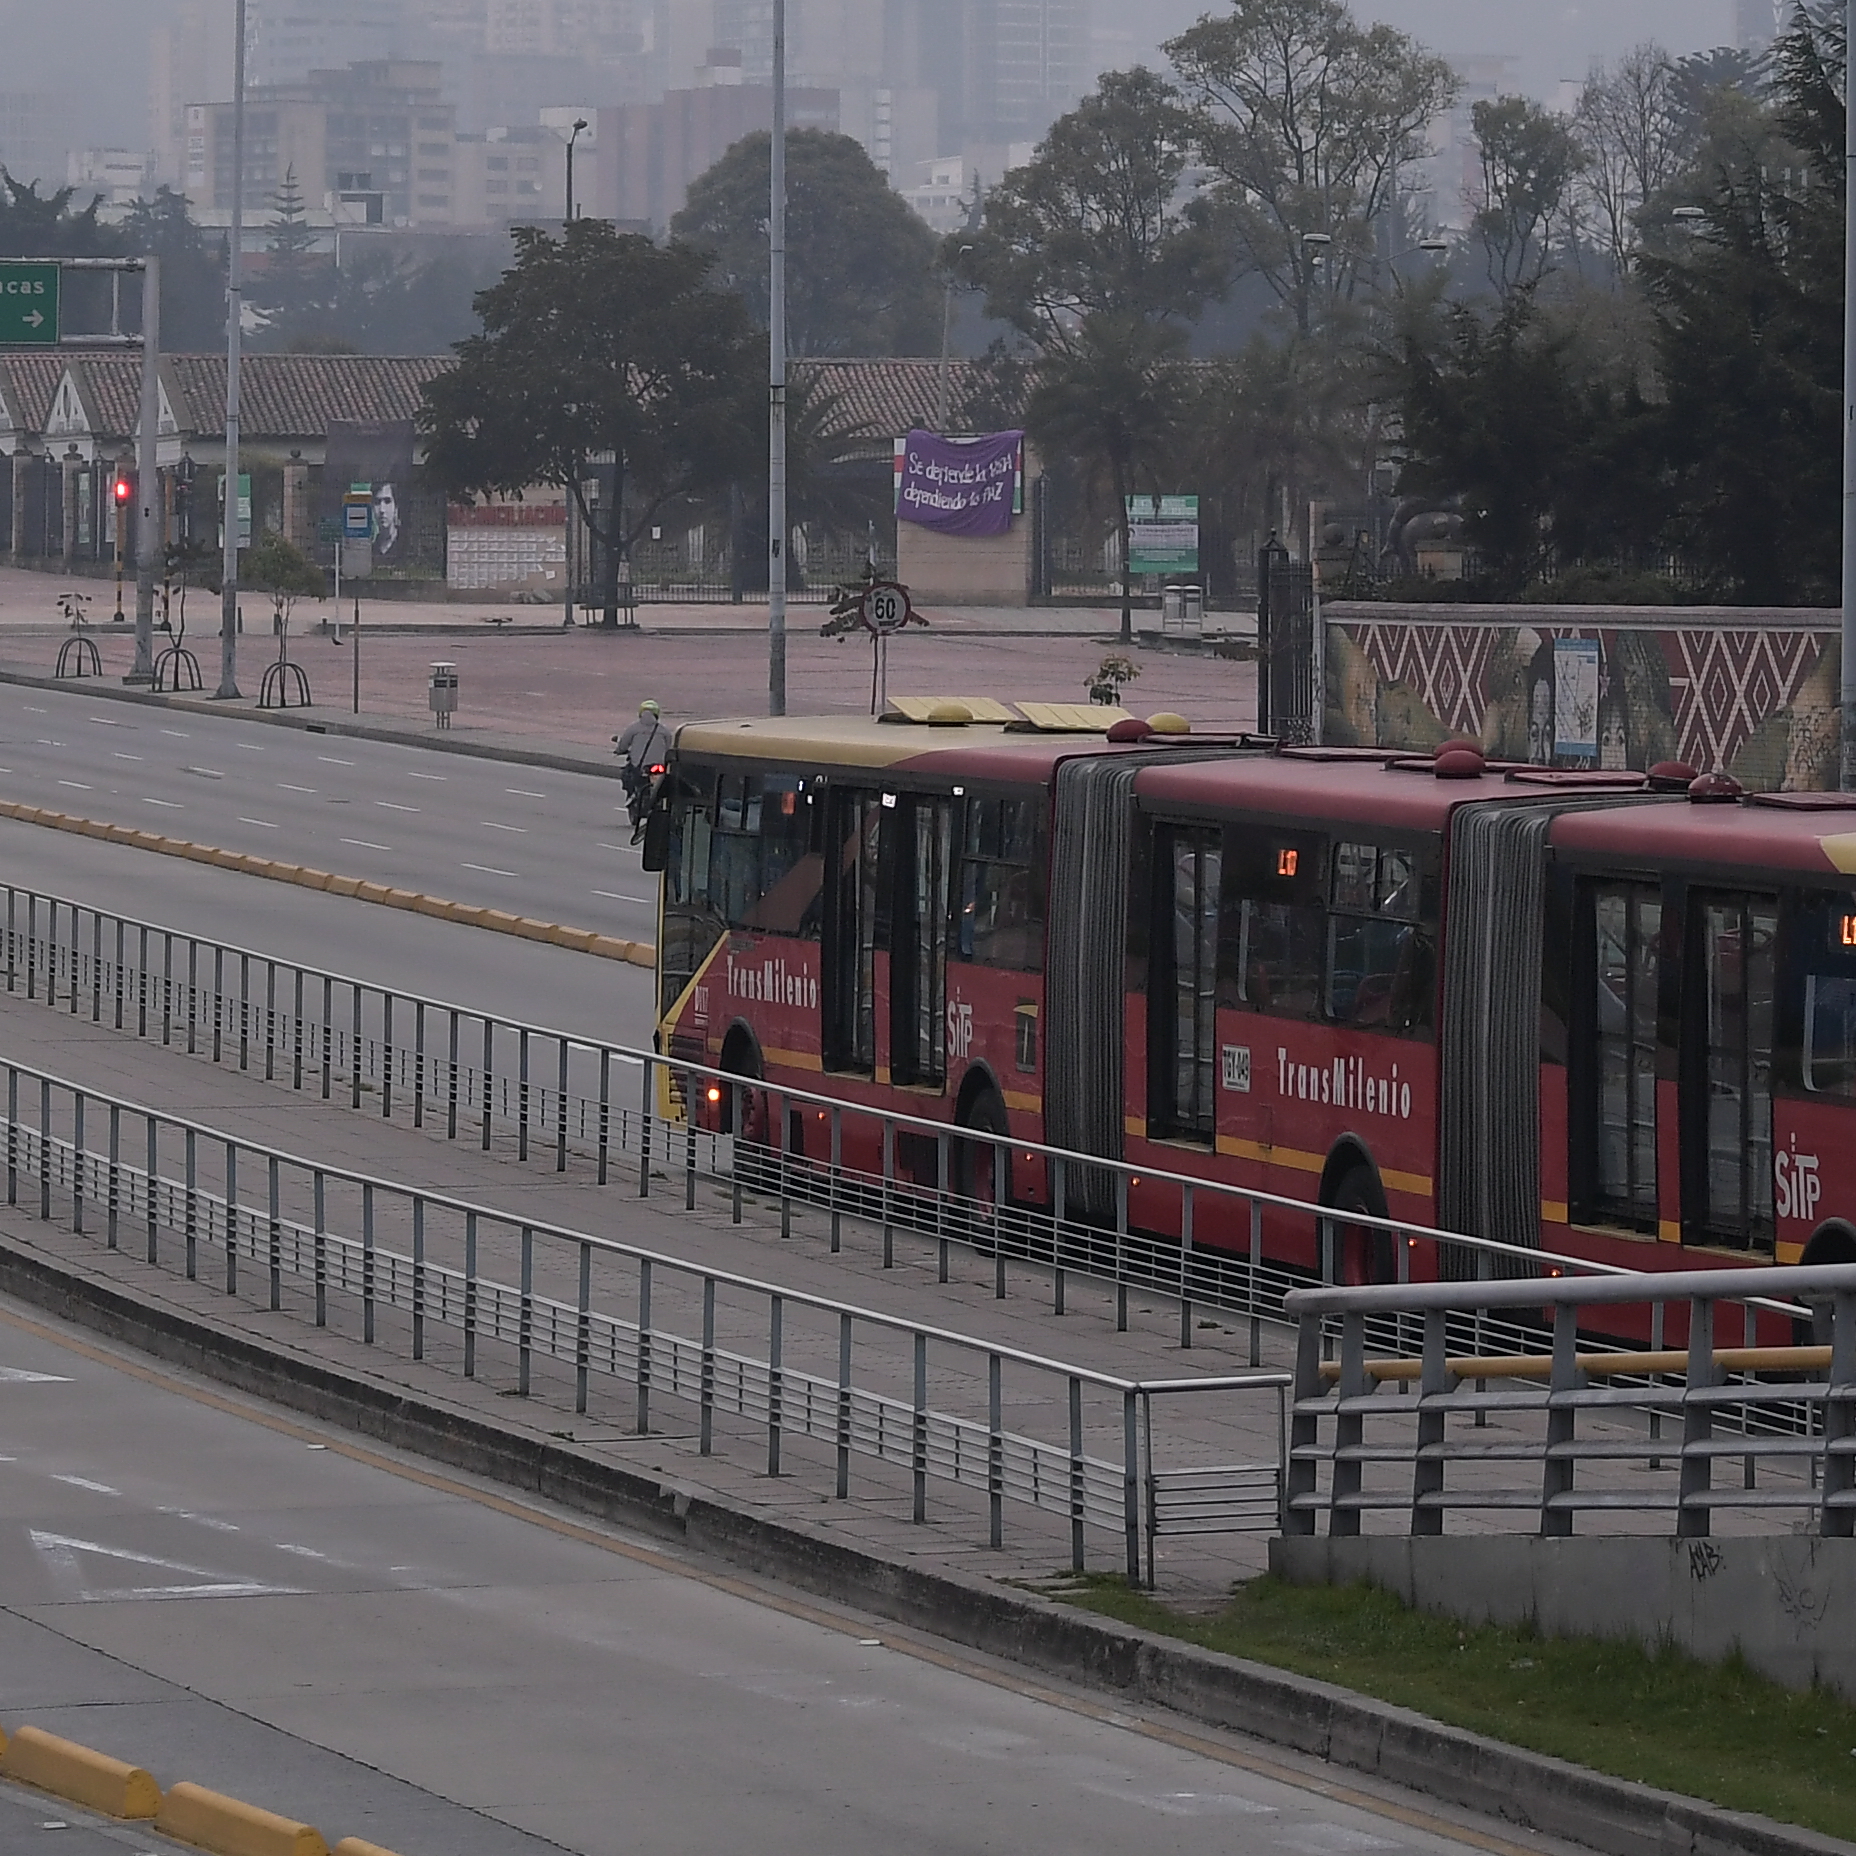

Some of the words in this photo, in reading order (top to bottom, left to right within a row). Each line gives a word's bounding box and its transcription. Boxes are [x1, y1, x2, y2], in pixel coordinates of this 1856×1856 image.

[875, 597, 896, 620] 60
[726, 954, 818, 1010] TransMilenio
[1276, 1045, 1412, 1120] TransMilenio
